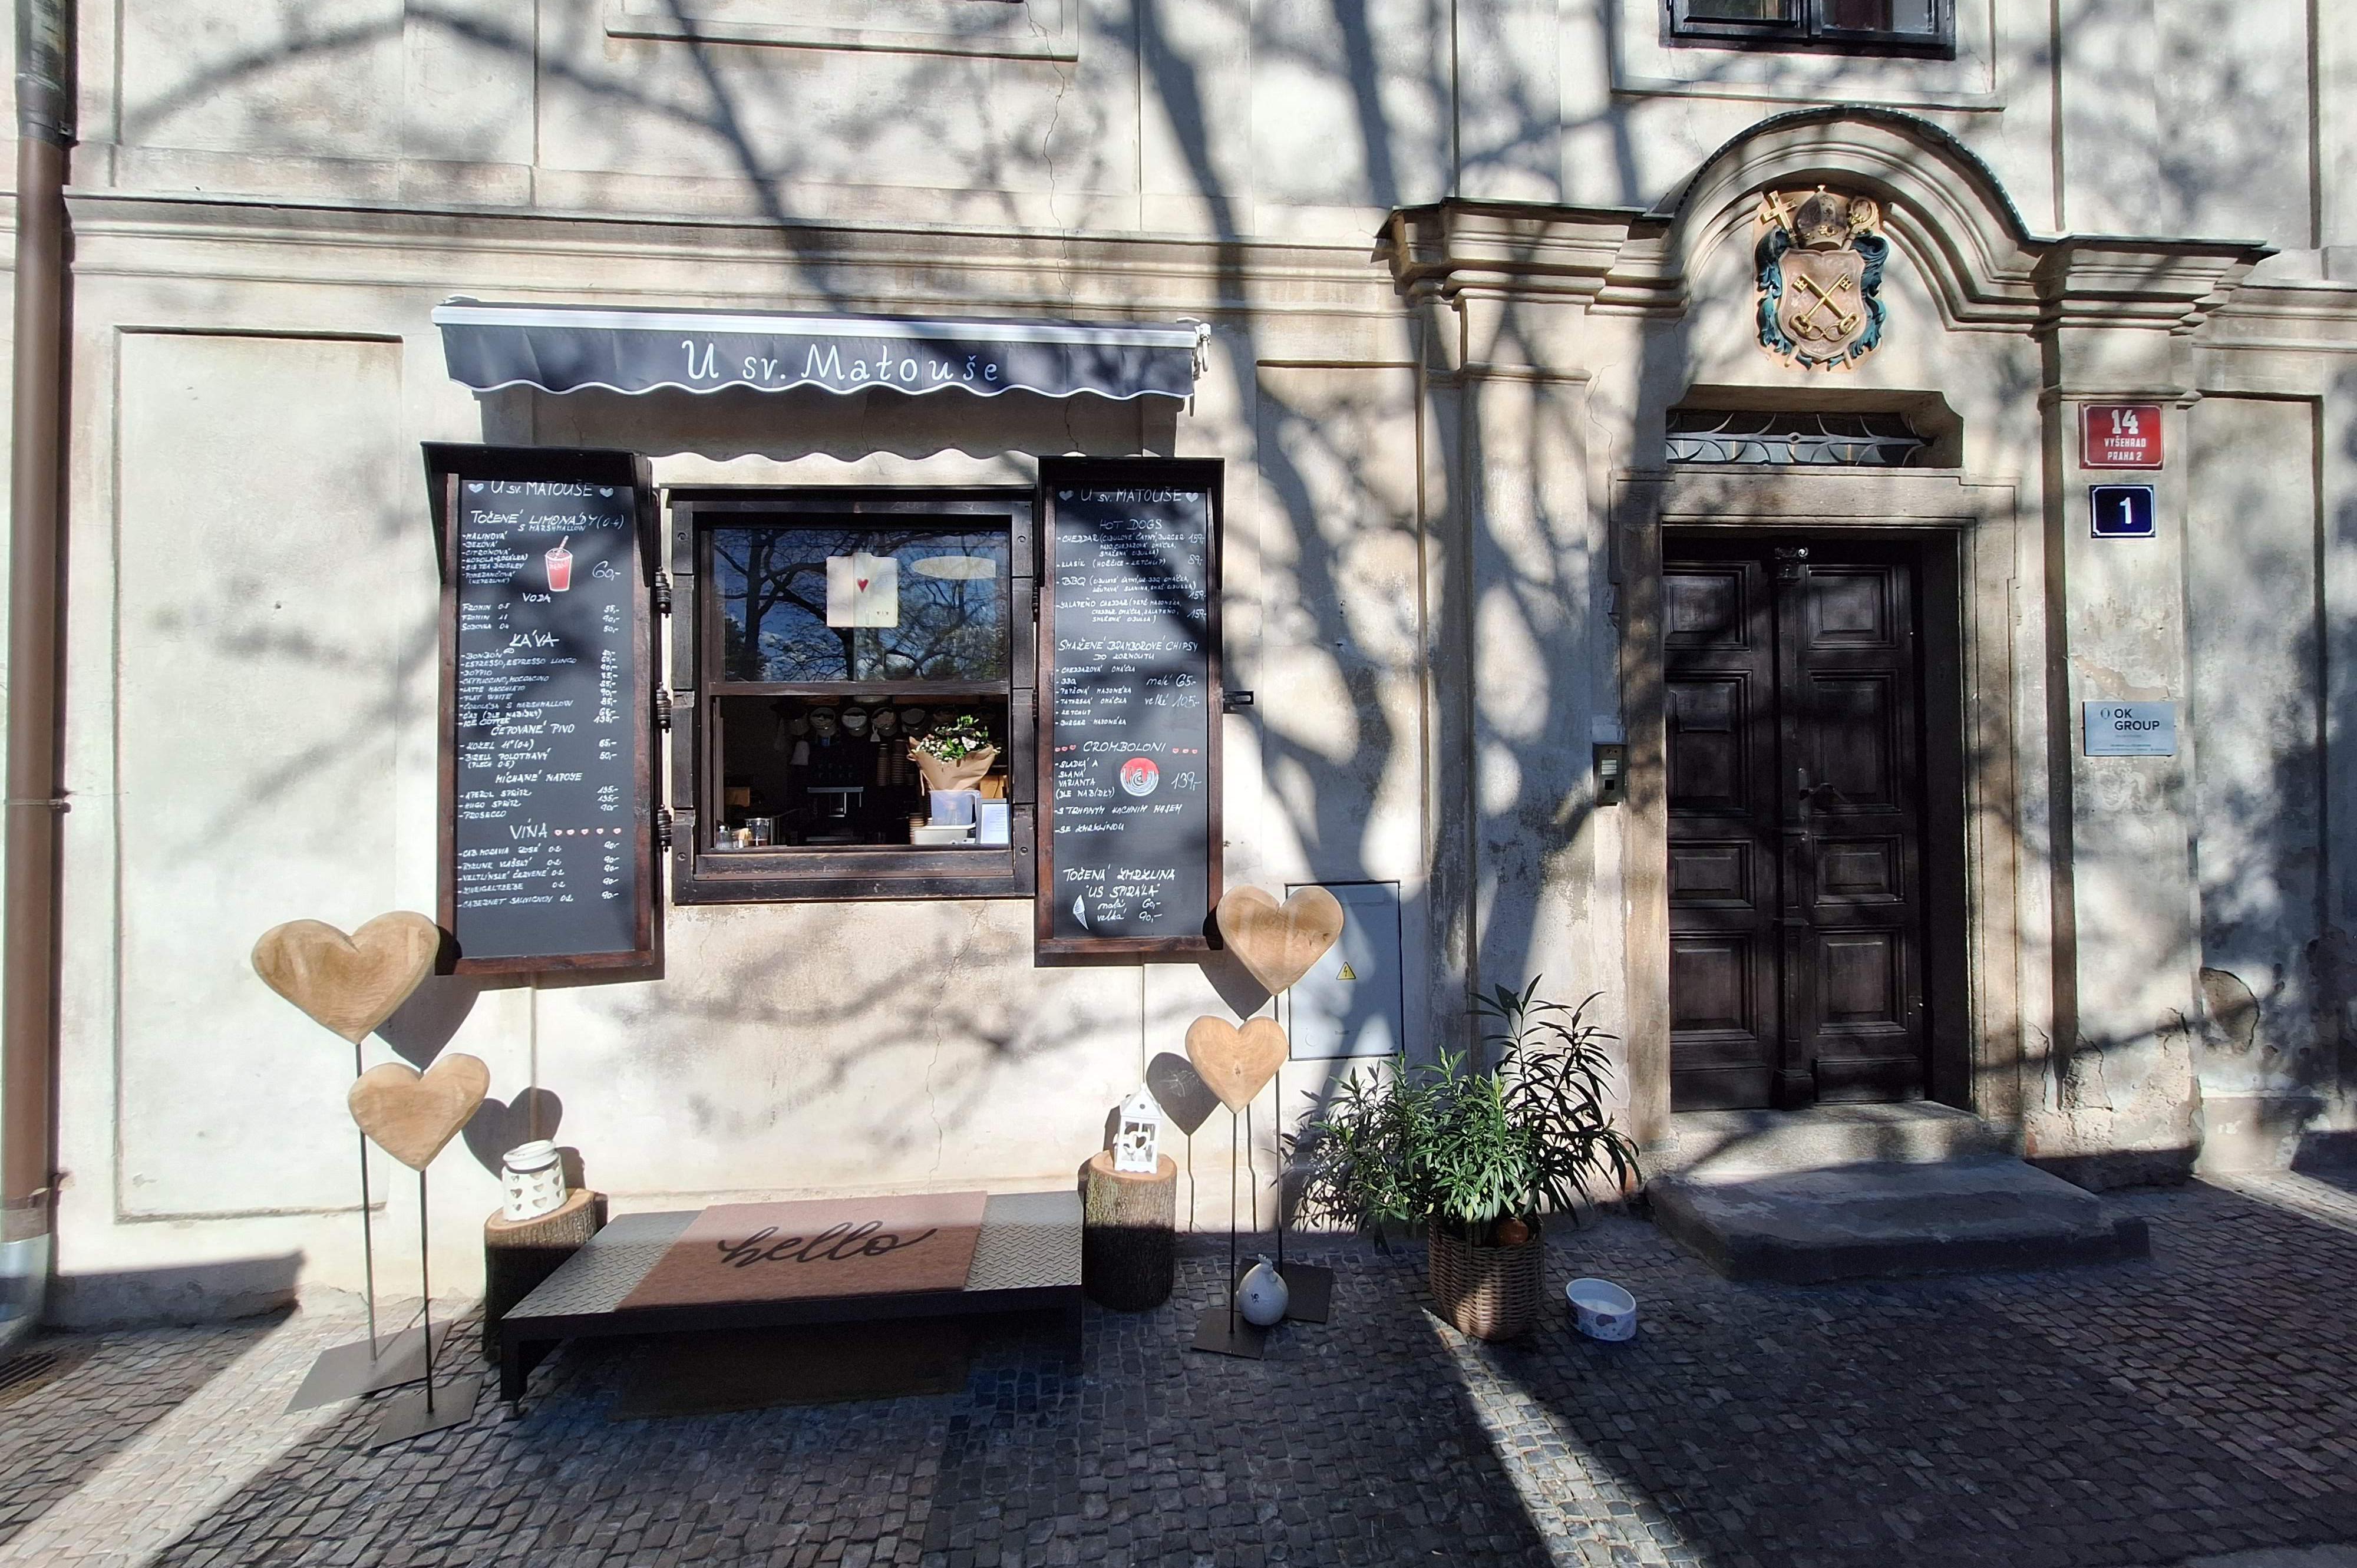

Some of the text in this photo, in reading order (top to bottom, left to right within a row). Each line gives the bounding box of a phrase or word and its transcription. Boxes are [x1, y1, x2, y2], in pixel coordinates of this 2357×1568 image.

[682, 340, 998, 381] U sv. Matouše
[2111, 409, 2138, 434] 14
[2104, 436, 2146, 447] VYŠEHRAD
[2107, 451, 2143, 461] PRAHA 2
[491, 481, 504, 493] U
[1081, 488, 1092, 501] U
[1116, 486, 1181, 502] MATOUŠE
[470, 509, 523, 523] TOČENÉ
[2120, 497, 2132, 524] 1
[1100, 519, 1162, 530] HOT DOGS
[1061, 576, 1086, 586] BBQ
[523, 593, 551, 603] VODA
[509, 629, 559, 648] KÁVA
[1058, 635, 1197, 652] SMAŽENÉ BRAMBOROVÉ CHIPSY
[1145, 694, 1169, 705] velké
[2114, 708, 2132, 718] OK
[550, 724, 575, 734] PIVO
[2114, 721, 2160, 731] GROUP
[1083, 741, 1166, 752] CROMBOLONI
[1059, 778, 1096, 787] VARIANTA
[1153, 804, 1183, 813] MASEM
[509, 818, 547, 840] VÍNA
[1063, 864, 1175, 882] TOČENÁ ZMRZLINA
[1097, 899, 1125, 910] malá
[1097, 908, 1127, 922] velká
[717, 1220, 938, 1268] hello
